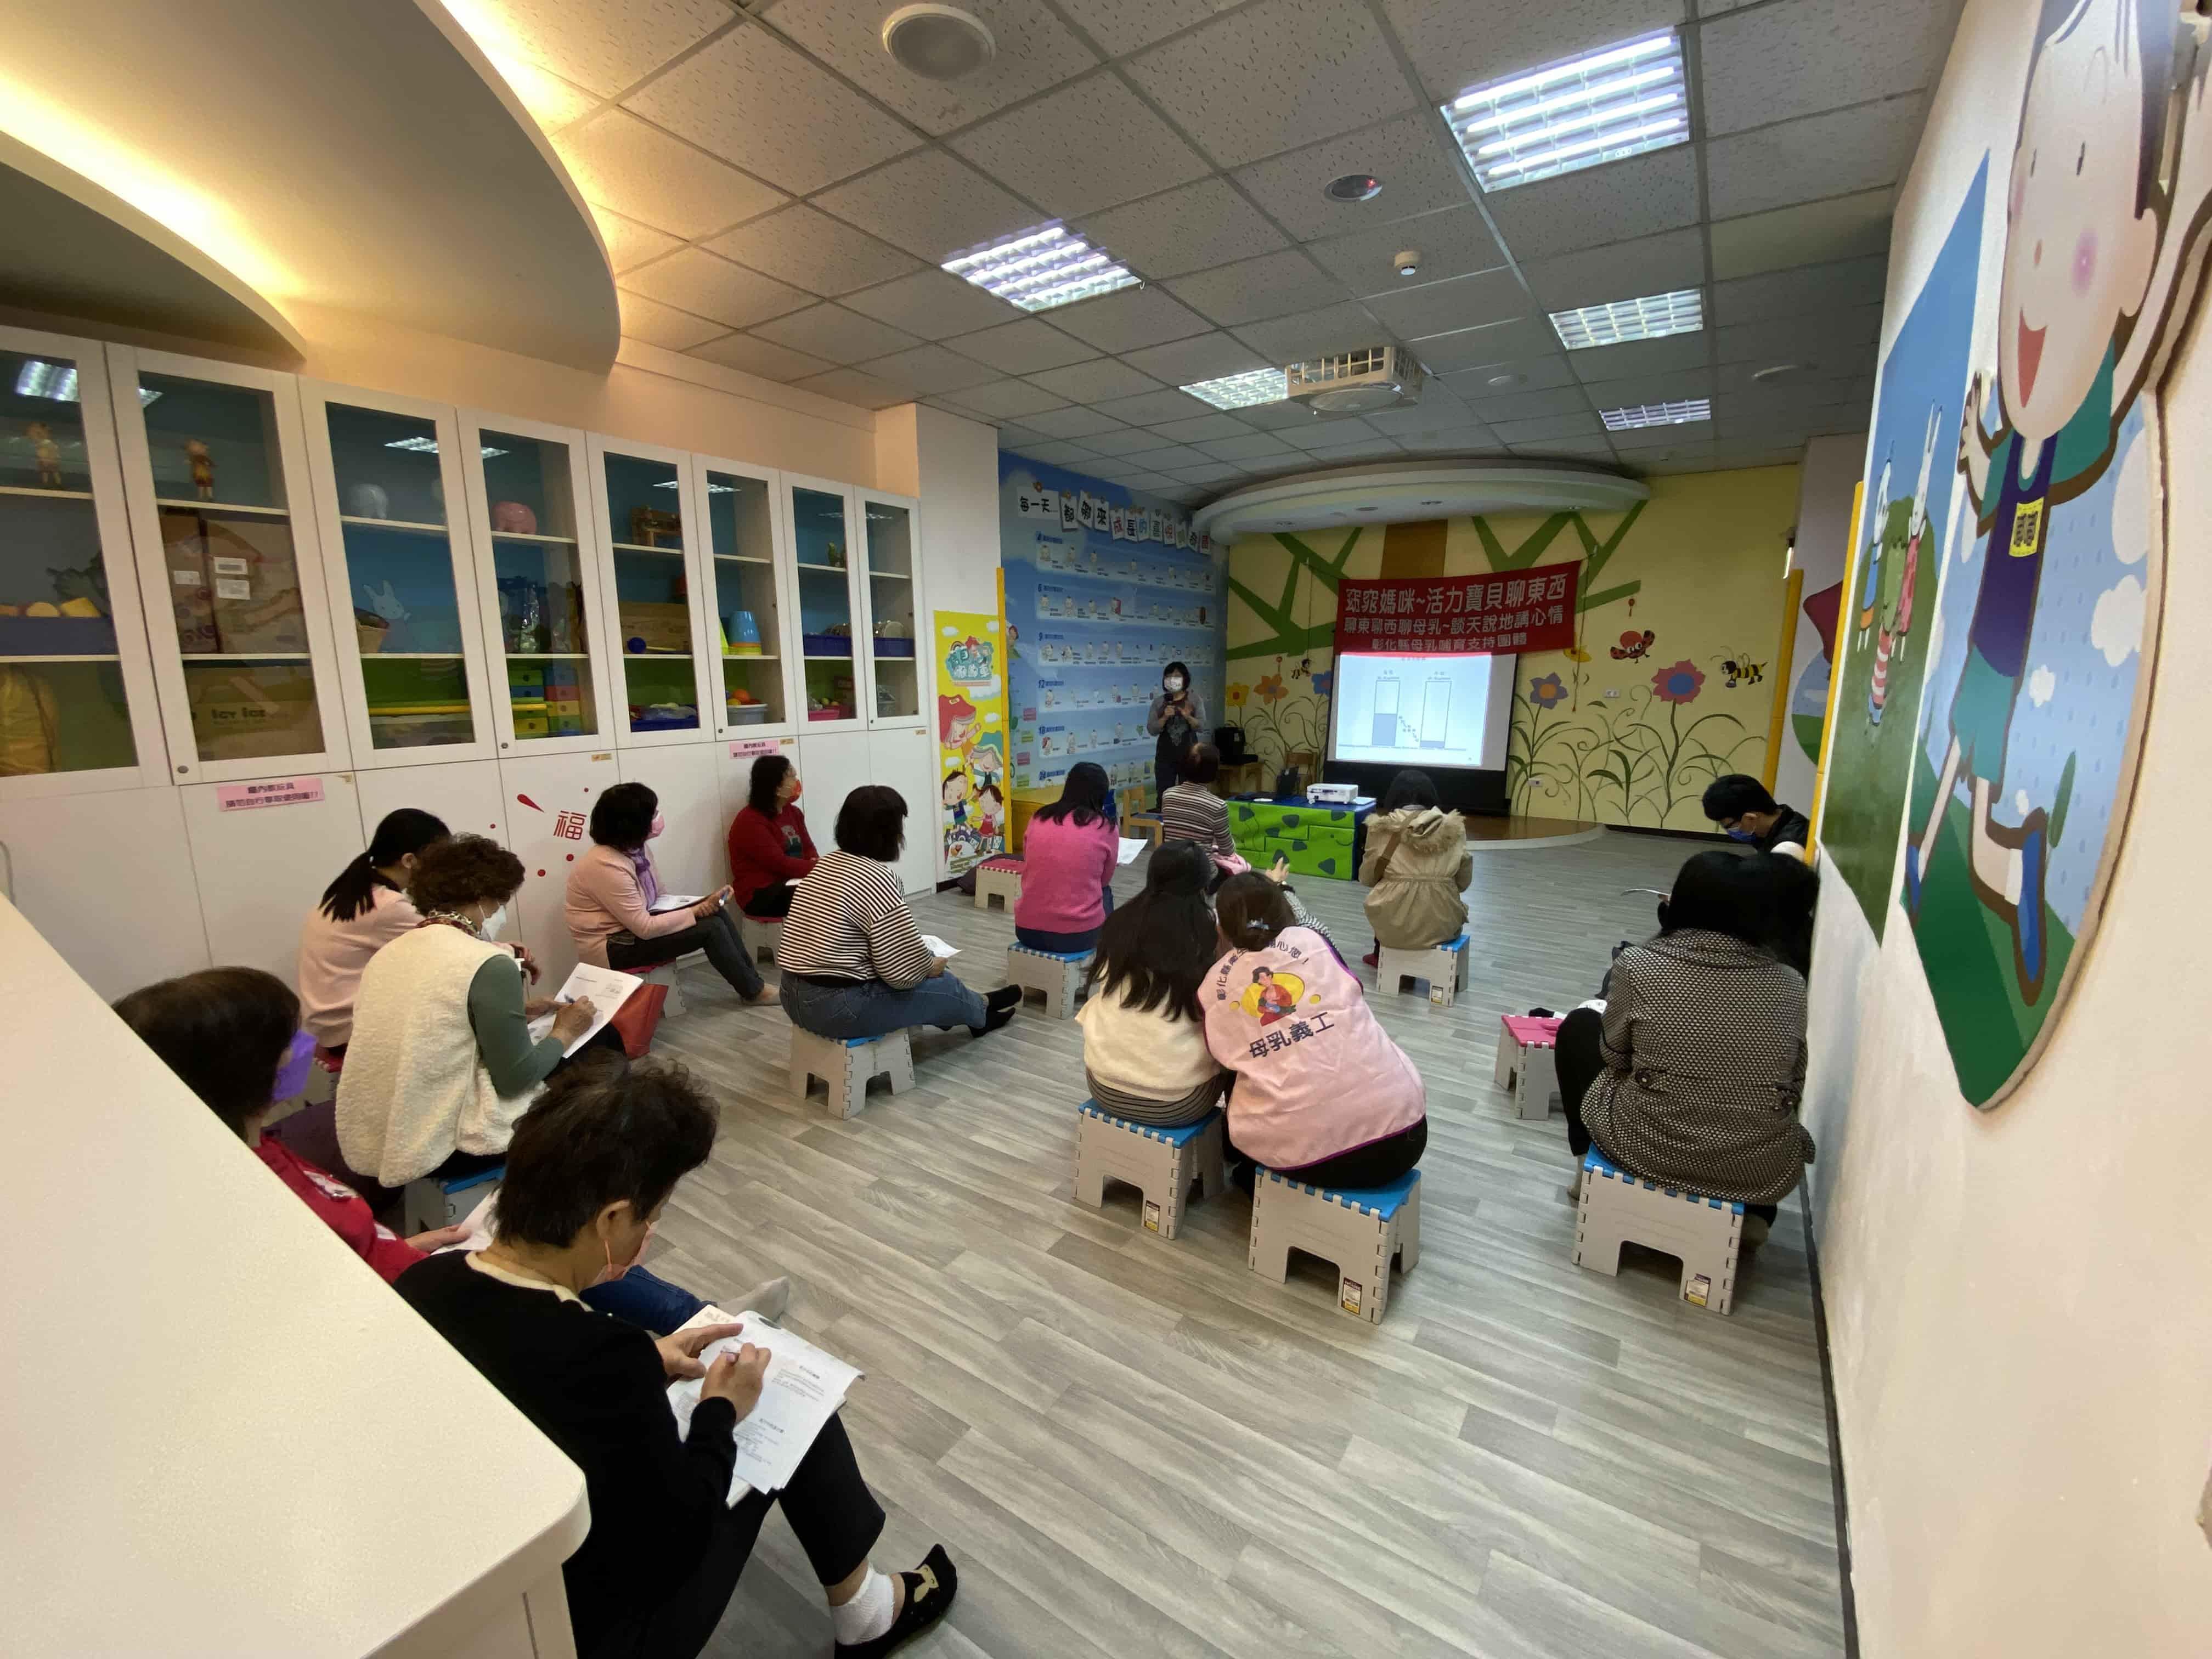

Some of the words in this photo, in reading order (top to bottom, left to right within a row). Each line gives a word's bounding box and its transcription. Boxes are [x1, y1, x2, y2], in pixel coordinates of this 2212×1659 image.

[553, 810, 587, 840] 福
[1249, 1012, 1334, 1058] 母乳義工
